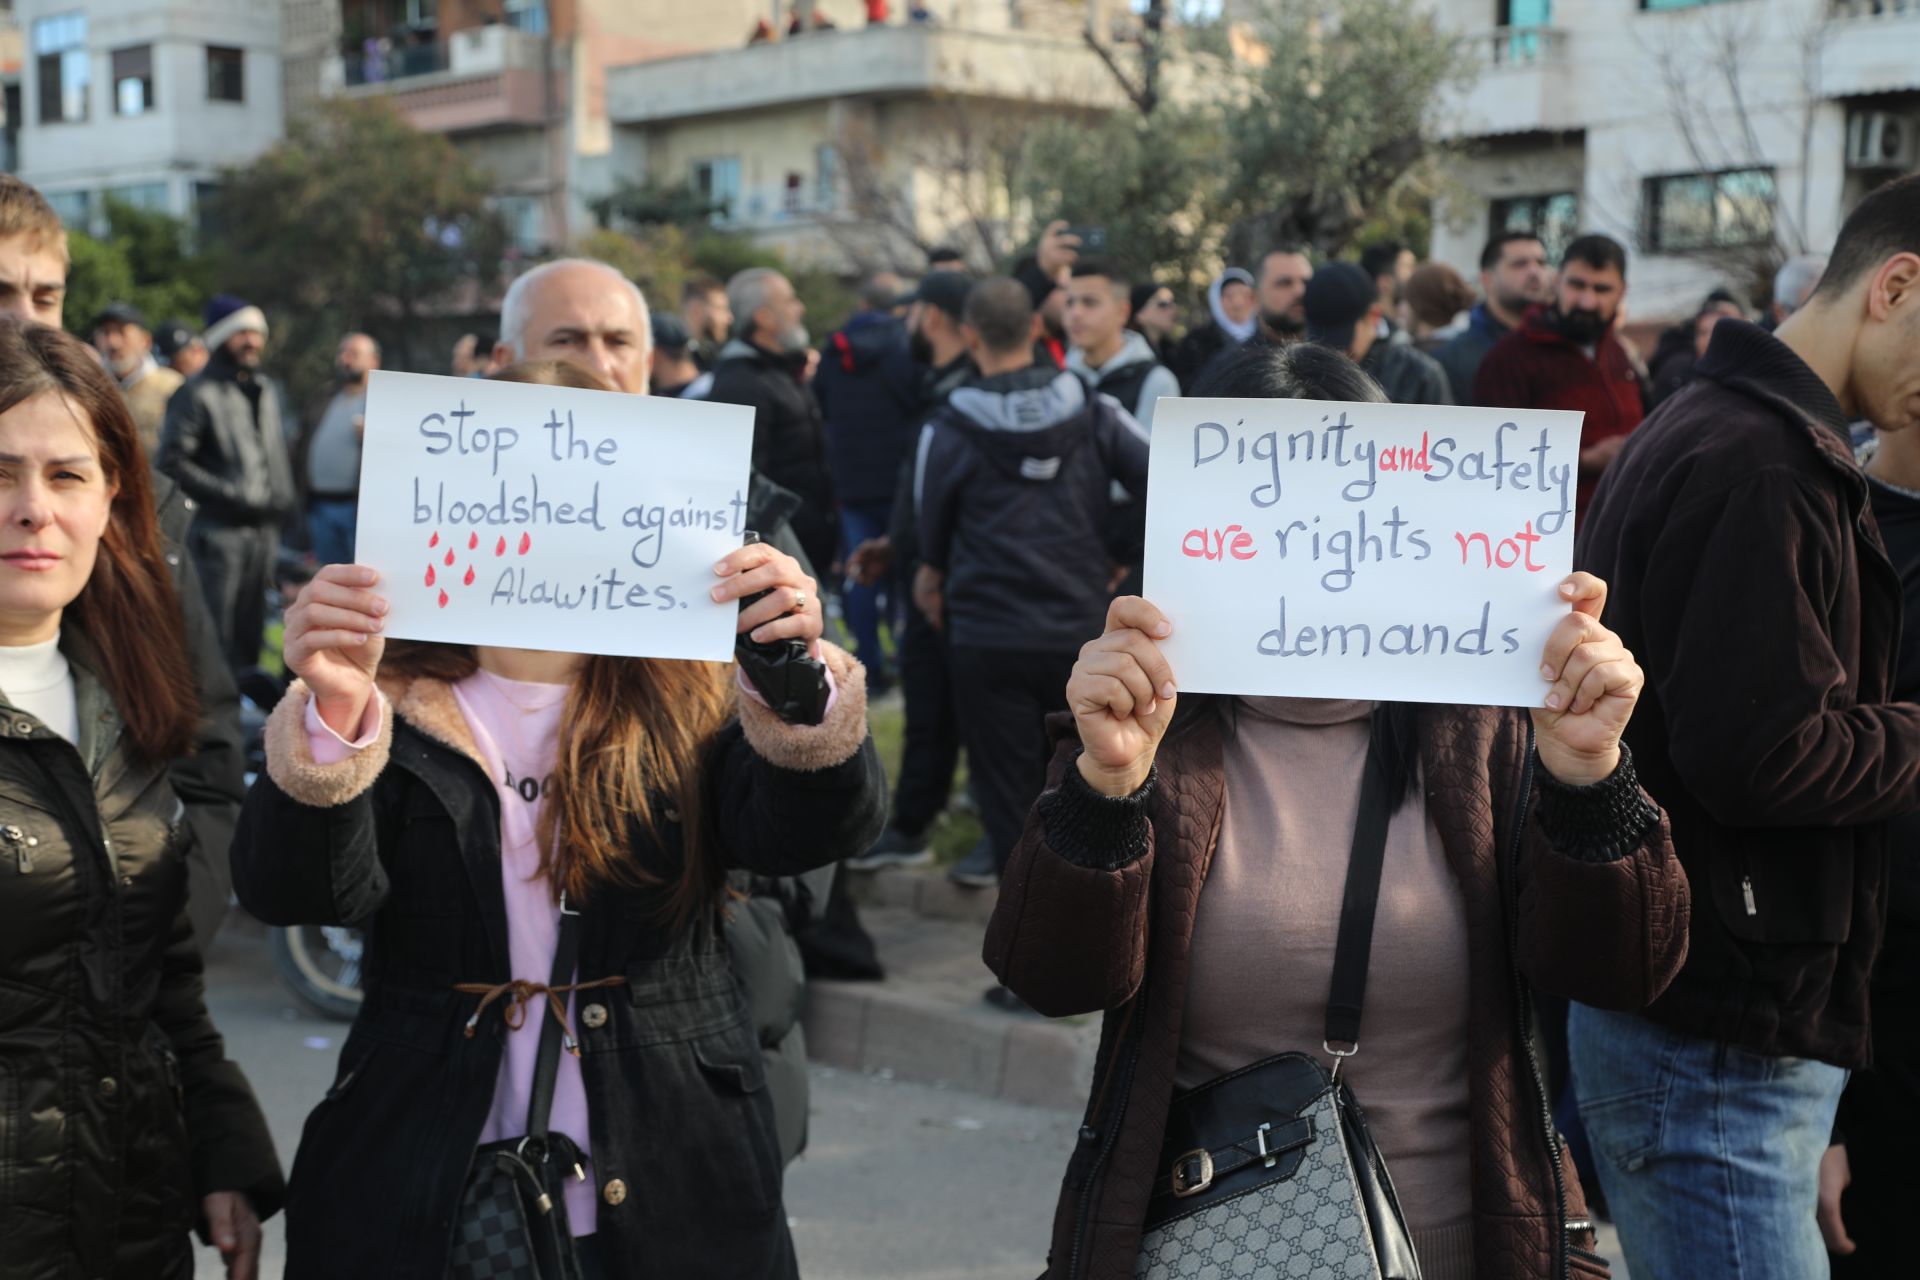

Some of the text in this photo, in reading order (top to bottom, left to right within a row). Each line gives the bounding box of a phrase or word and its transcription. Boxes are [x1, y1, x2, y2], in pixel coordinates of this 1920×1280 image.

[419, 400, 618, 475] Stop the
[1193, 411, 1377, 508] Dignity
[1378, 431, 1433, 472] and
[413, 473, 748, 568] bloodshed against
[1181, 506, 1546, 592] are rights not
[491, 567, 688, 611] Alawites.
[1256, 596, 1520, 657] demands
